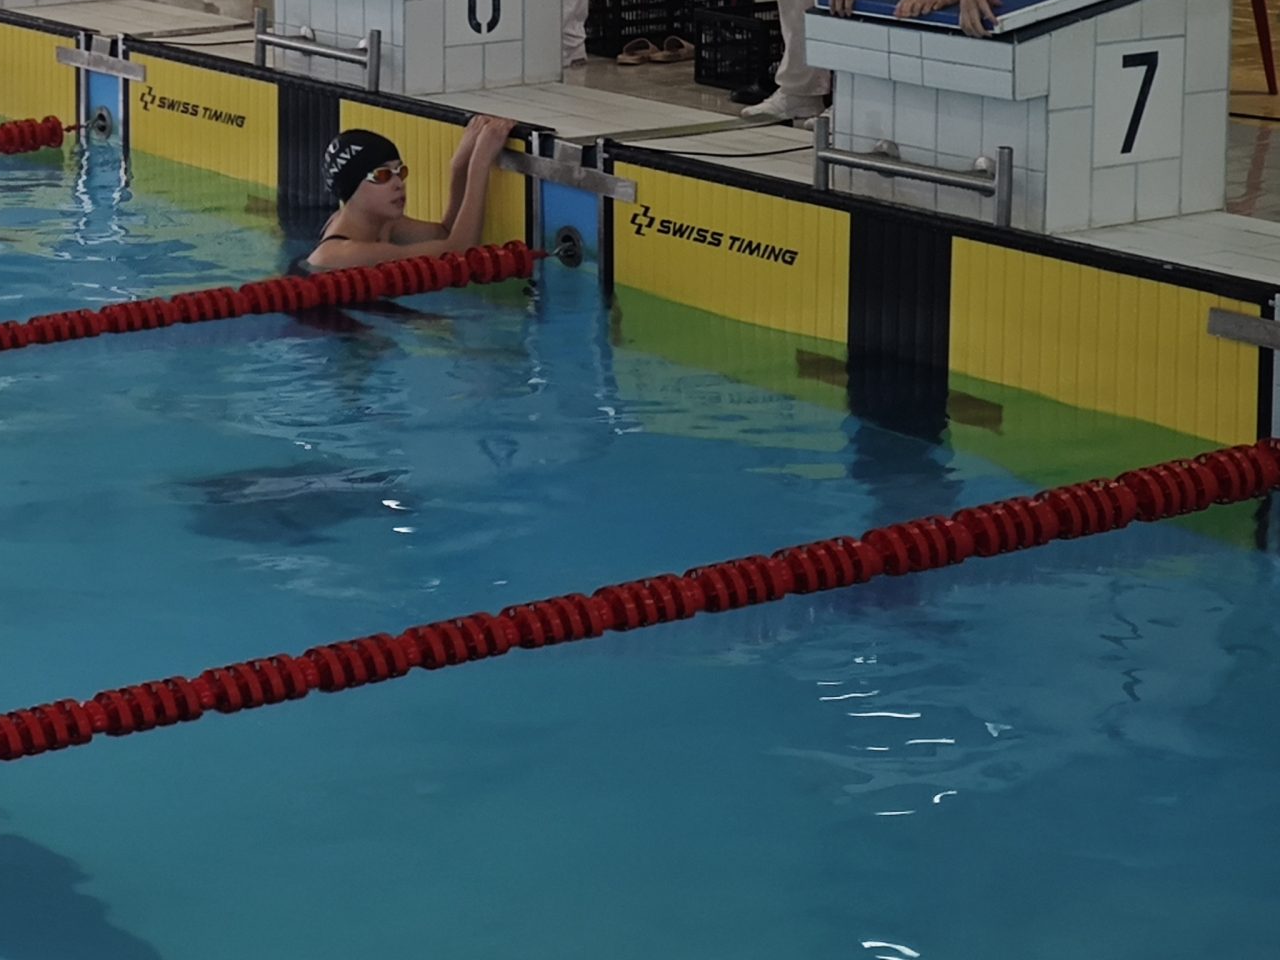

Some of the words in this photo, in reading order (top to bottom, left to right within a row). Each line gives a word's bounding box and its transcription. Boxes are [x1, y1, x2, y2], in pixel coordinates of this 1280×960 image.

[157, 96, 200, 117] SWISS
[202, 106, 246, 128] TIMING
[1120, 50, 1159, 155] 7
[656, 218, 724, 248] SWISS
[728, 236, 799, 266] TIMING
